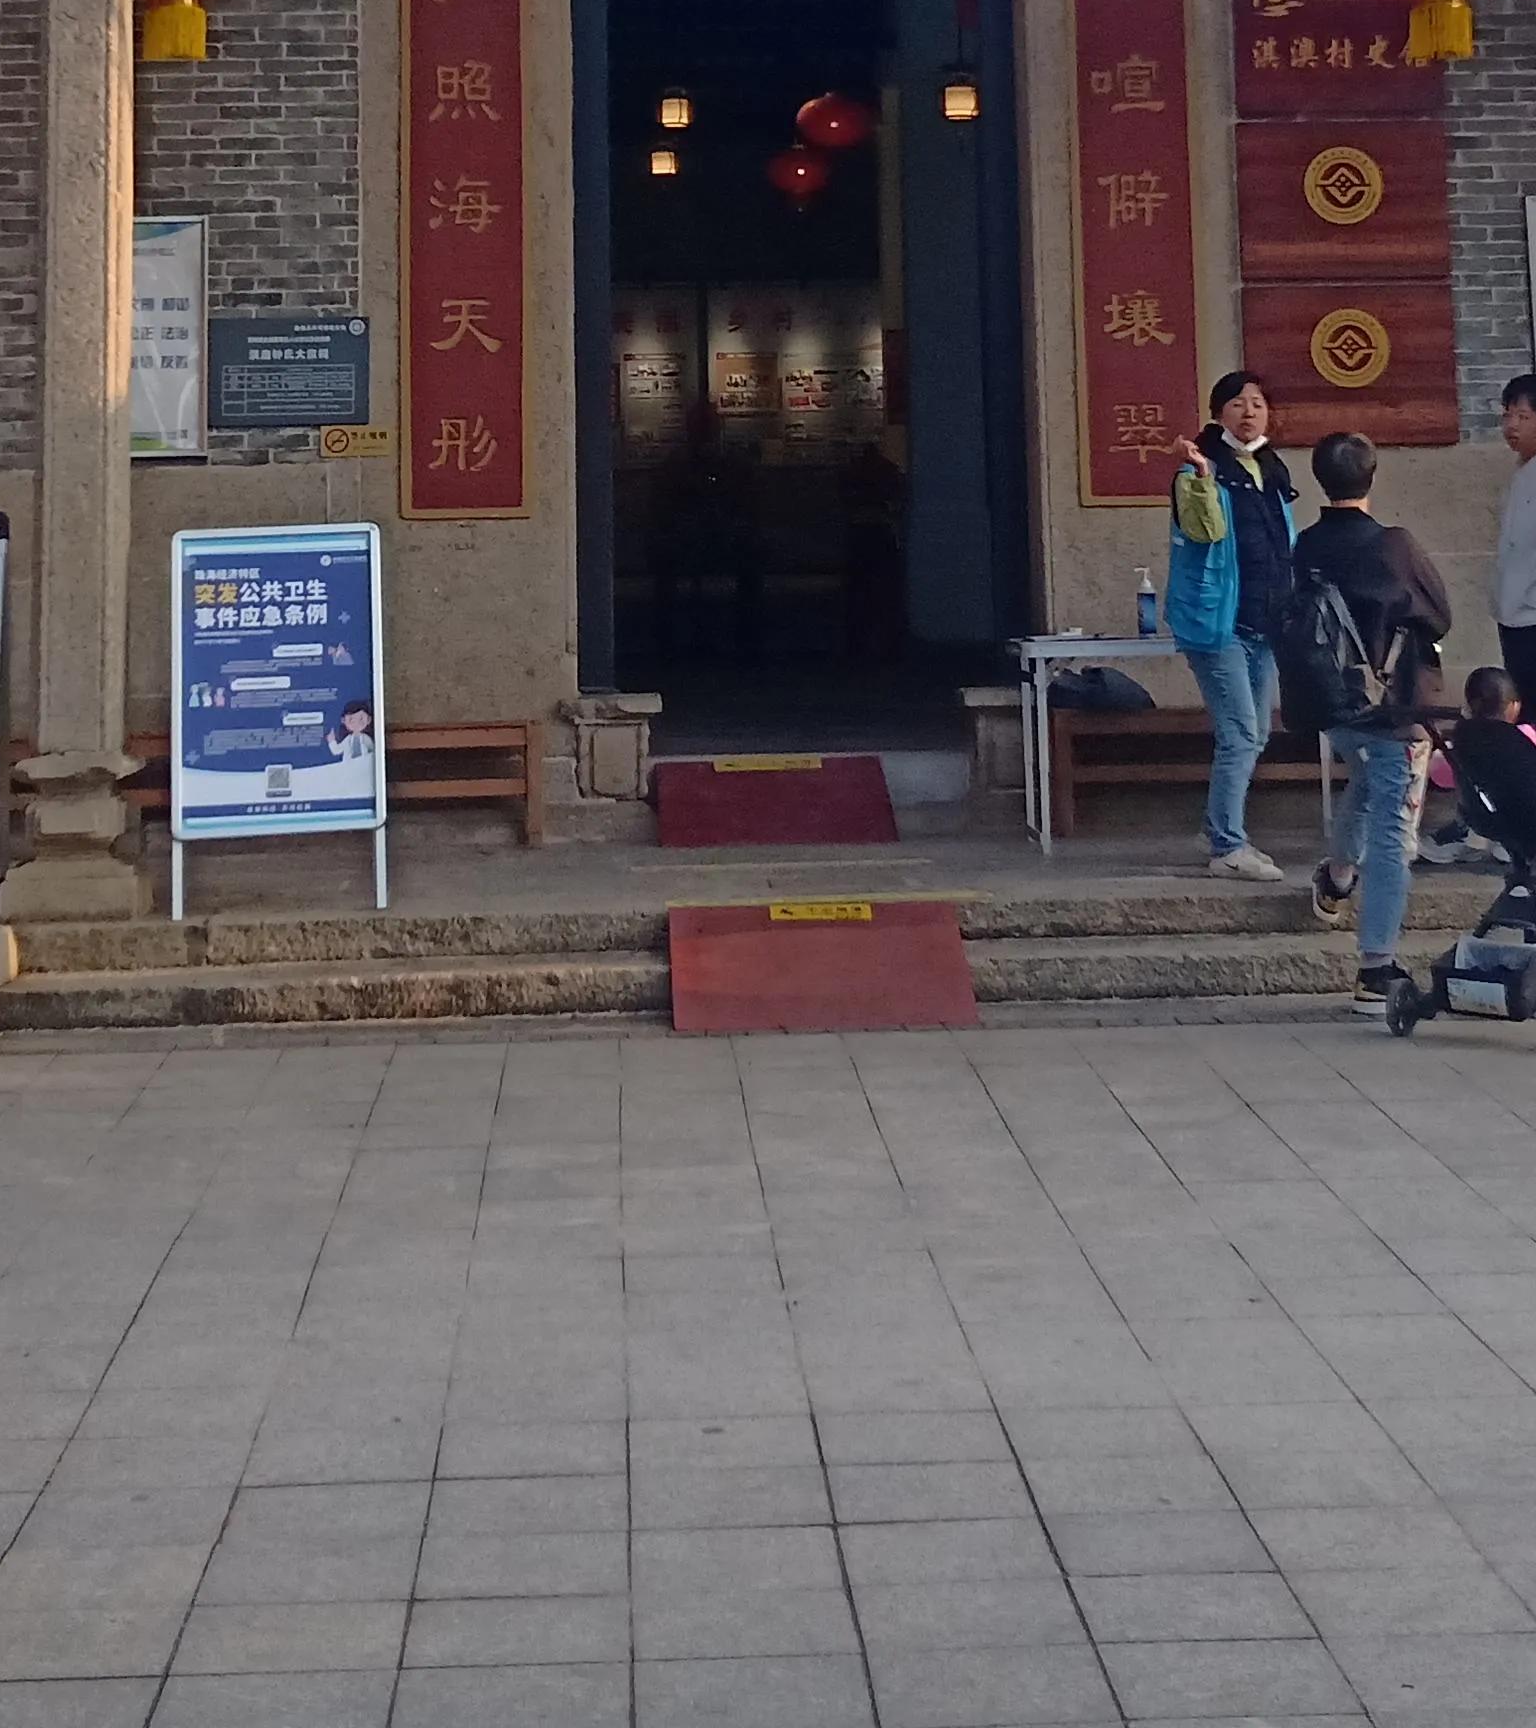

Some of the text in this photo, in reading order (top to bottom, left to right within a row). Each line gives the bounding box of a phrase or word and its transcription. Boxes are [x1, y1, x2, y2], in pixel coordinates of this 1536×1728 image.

[1251, 34, 1430, 69] 淇澳村史
[193, 579, 328, 605] 突发公共卫生
[193, 603, 328, 629] 事件应急条例
